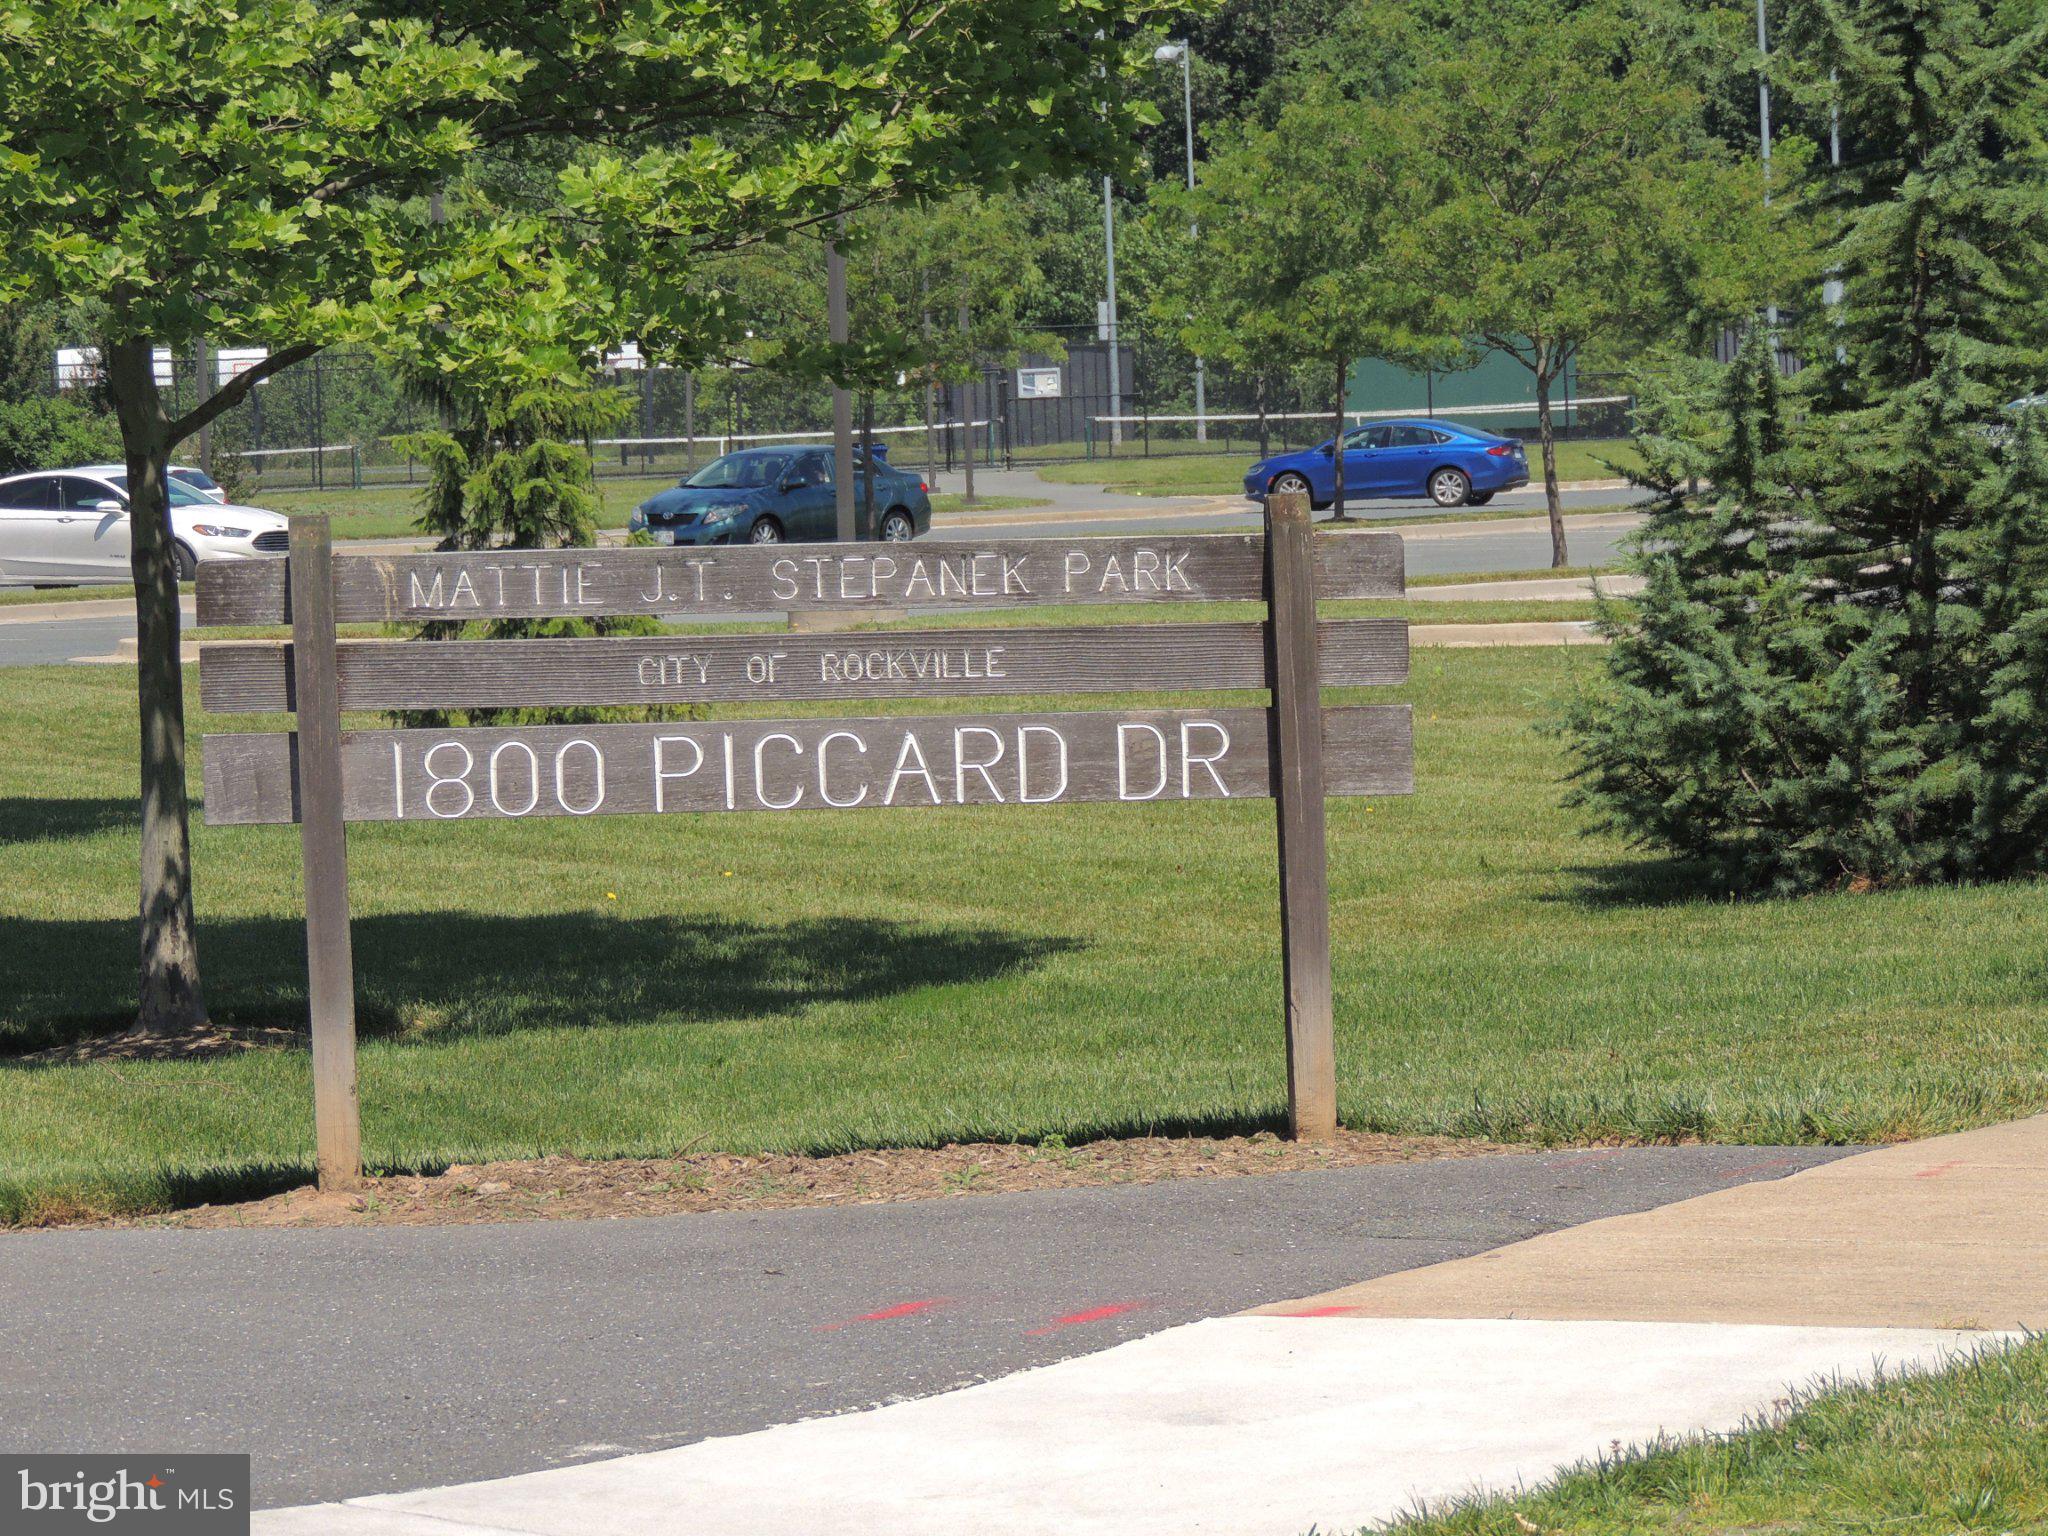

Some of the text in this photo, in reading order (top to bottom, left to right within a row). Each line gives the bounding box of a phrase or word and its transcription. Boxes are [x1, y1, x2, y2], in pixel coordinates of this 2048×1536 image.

[409, 548, 1192, 608] MATTIE J.T. STEPANEK PARK
[637, 647, 1007, 686] CITY OF ROCKVILLE
[393, 720, 1231, 819] 1800 PICCARD DR
